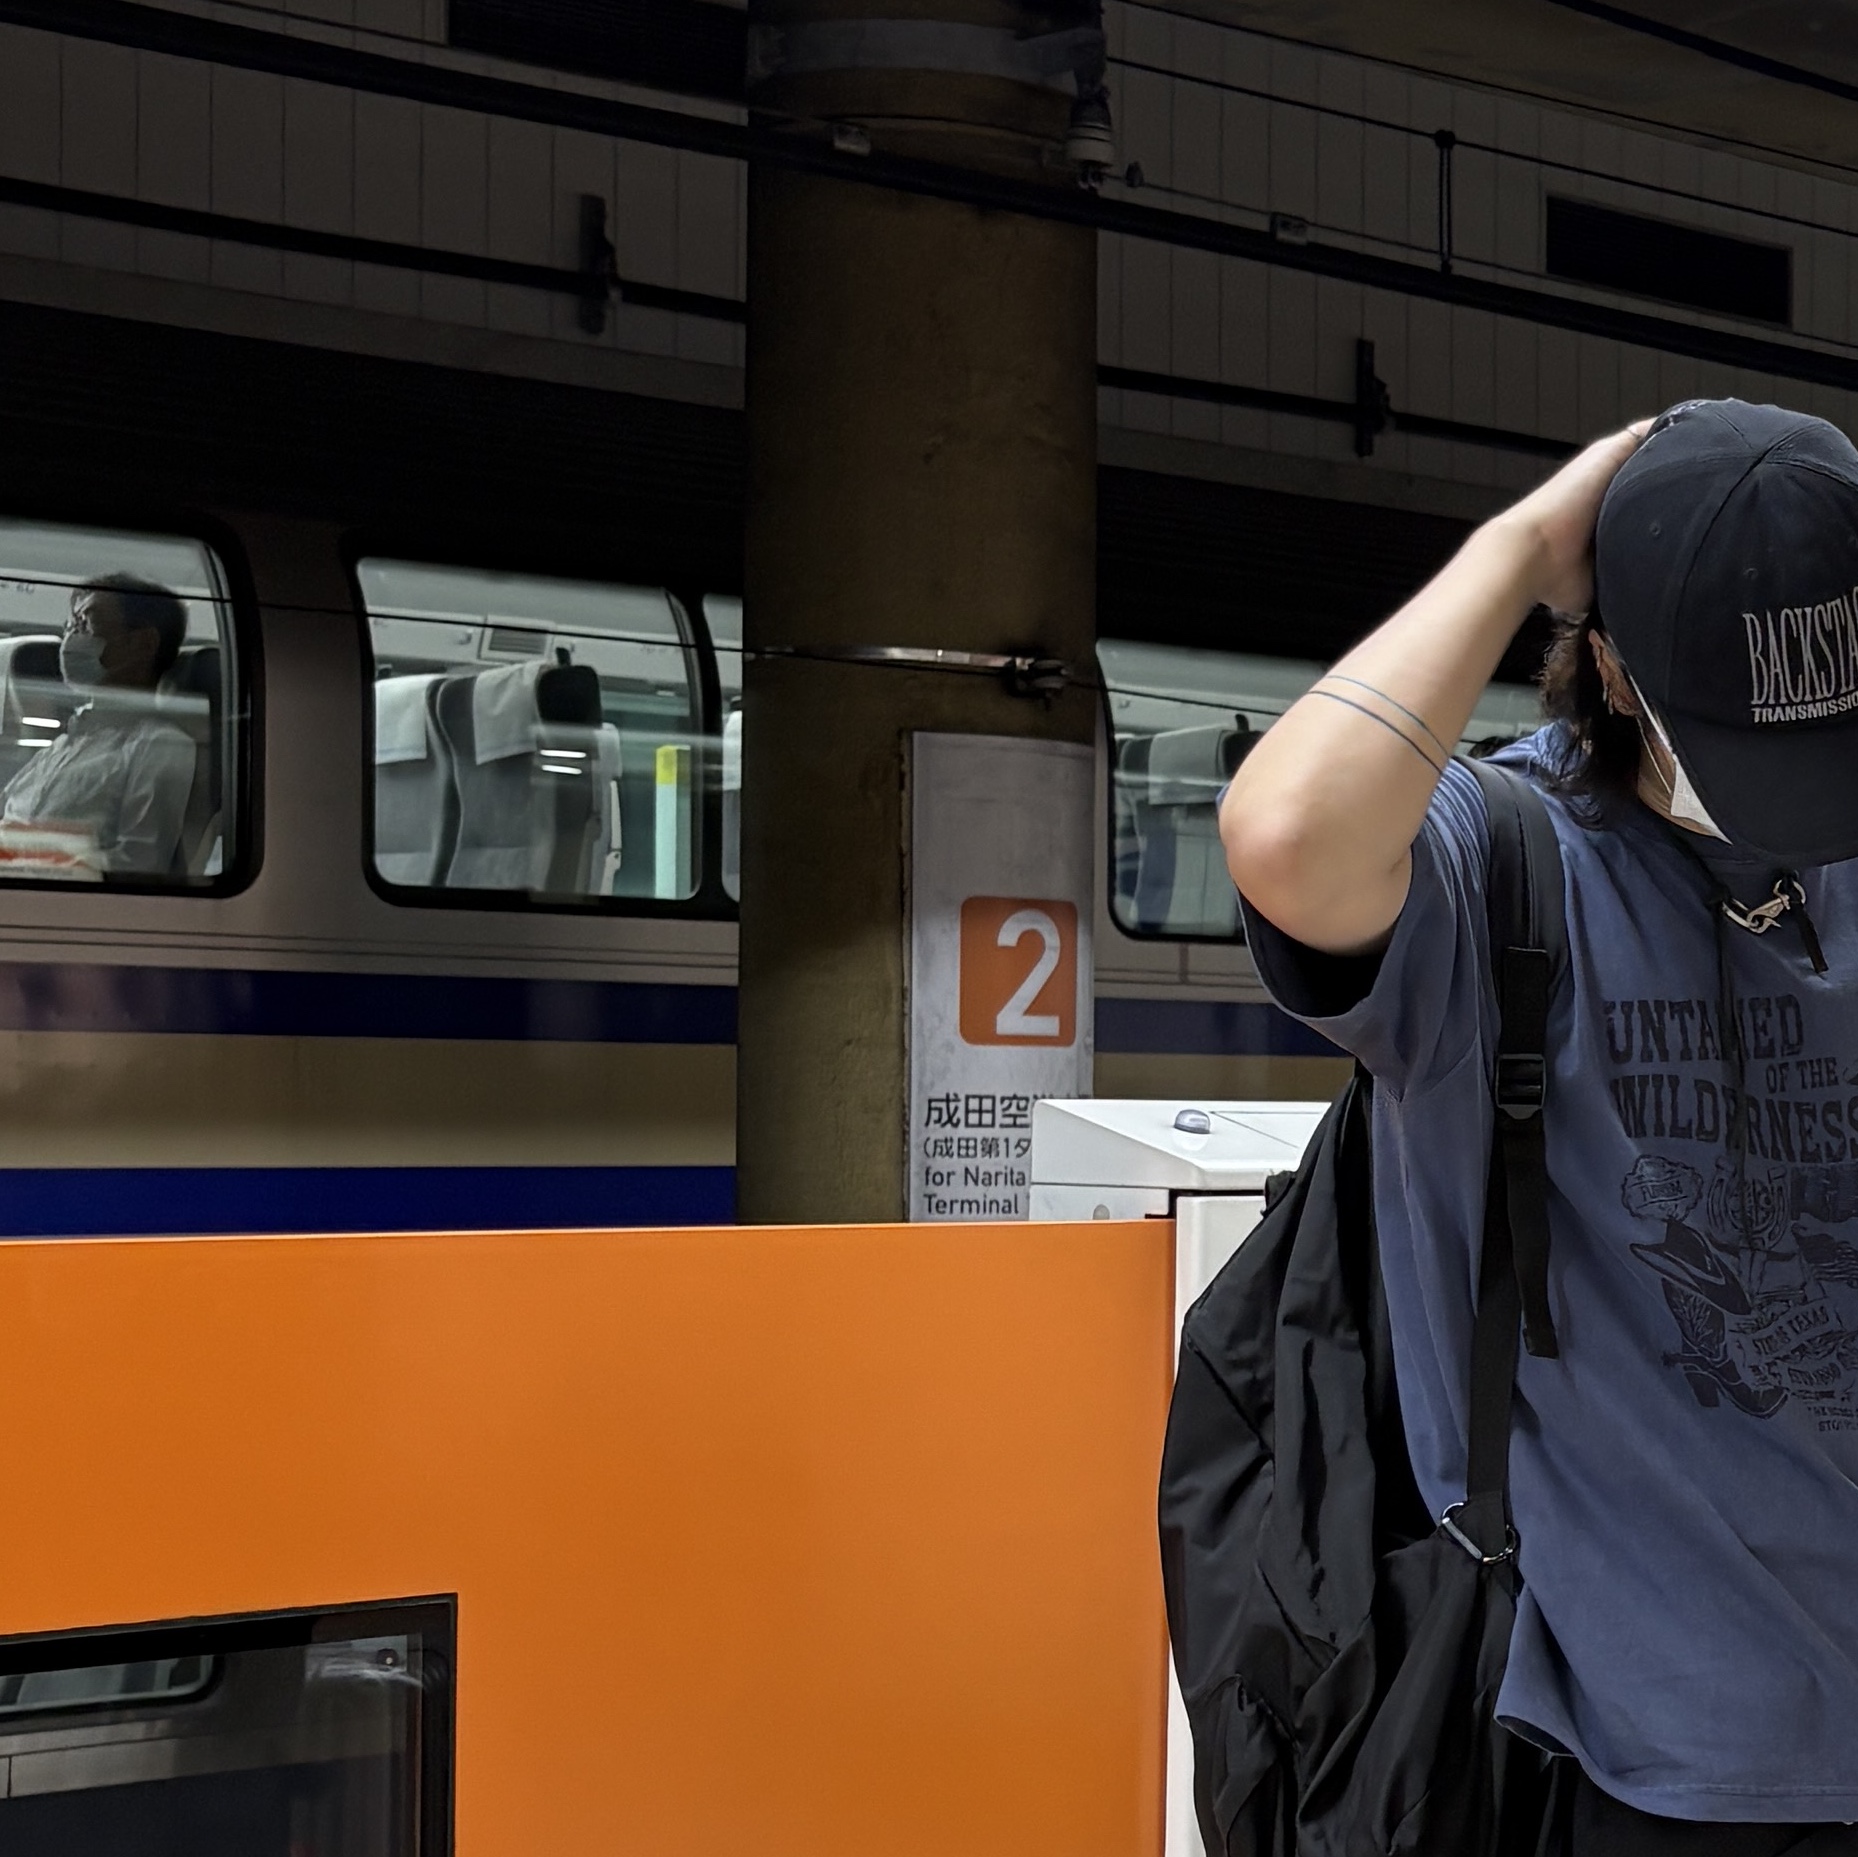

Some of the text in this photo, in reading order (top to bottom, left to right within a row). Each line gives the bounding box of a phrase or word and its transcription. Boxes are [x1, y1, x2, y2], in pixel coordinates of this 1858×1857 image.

[996, 909, 1061, 1036] 2
[1765, 1057, 1839, 1094] OF THE
[924, 1092, 1053, 1129] 成田空
[925, 1166, 1026, 1187] for Narita
[923, 1193, 1019, 1215] Terminal
